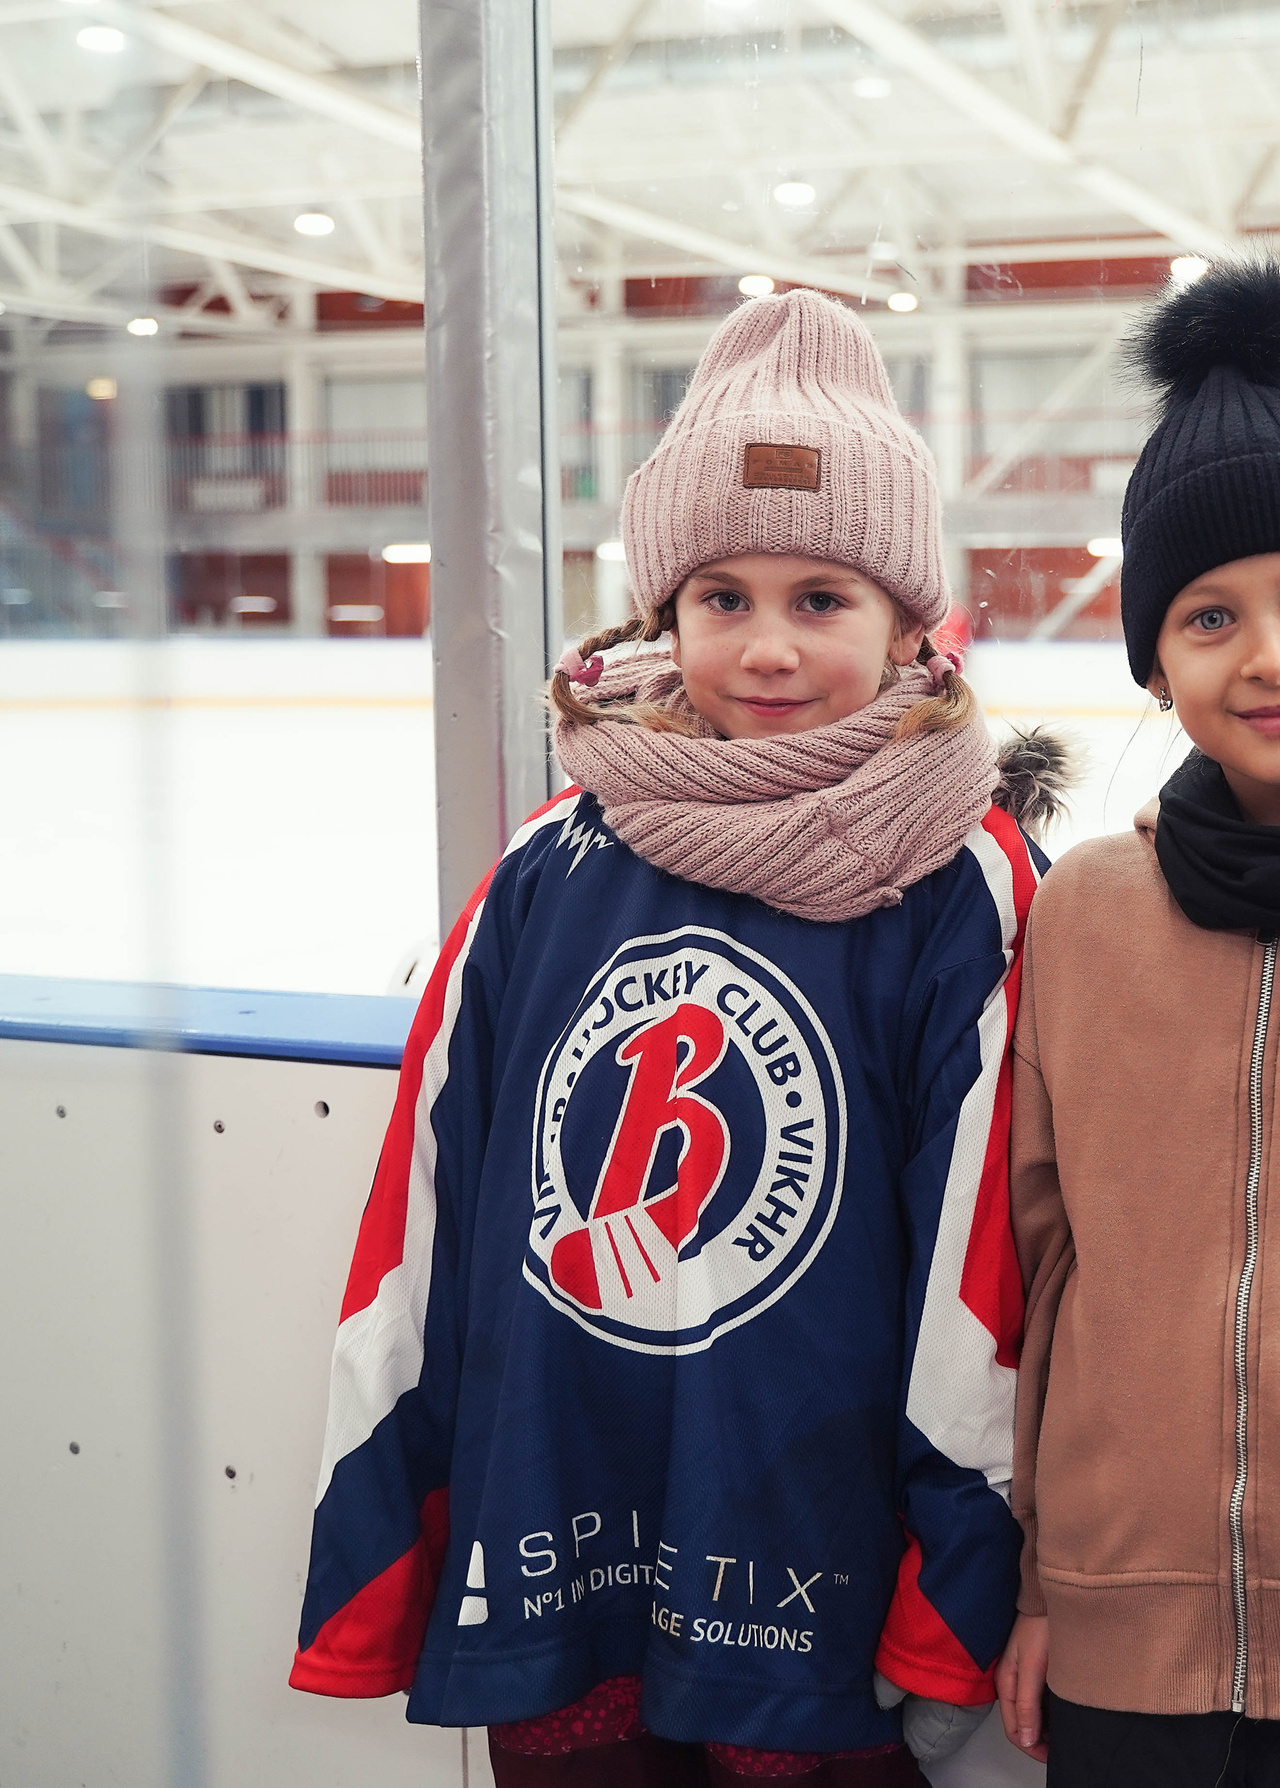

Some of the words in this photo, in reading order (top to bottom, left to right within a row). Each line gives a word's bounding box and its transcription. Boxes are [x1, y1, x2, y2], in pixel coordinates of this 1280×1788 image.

[716, 983, 801, 1086] CLUB
[731, 1118, 814, 1262] VIKHR
[518, 1510, 823, 1613] SPIETIX
[571, 1575, 585, 1603] IN
[590, 1563, 656, 1592] DIGIT
[690, 1618, 814, 1653] SOLUTIONS
